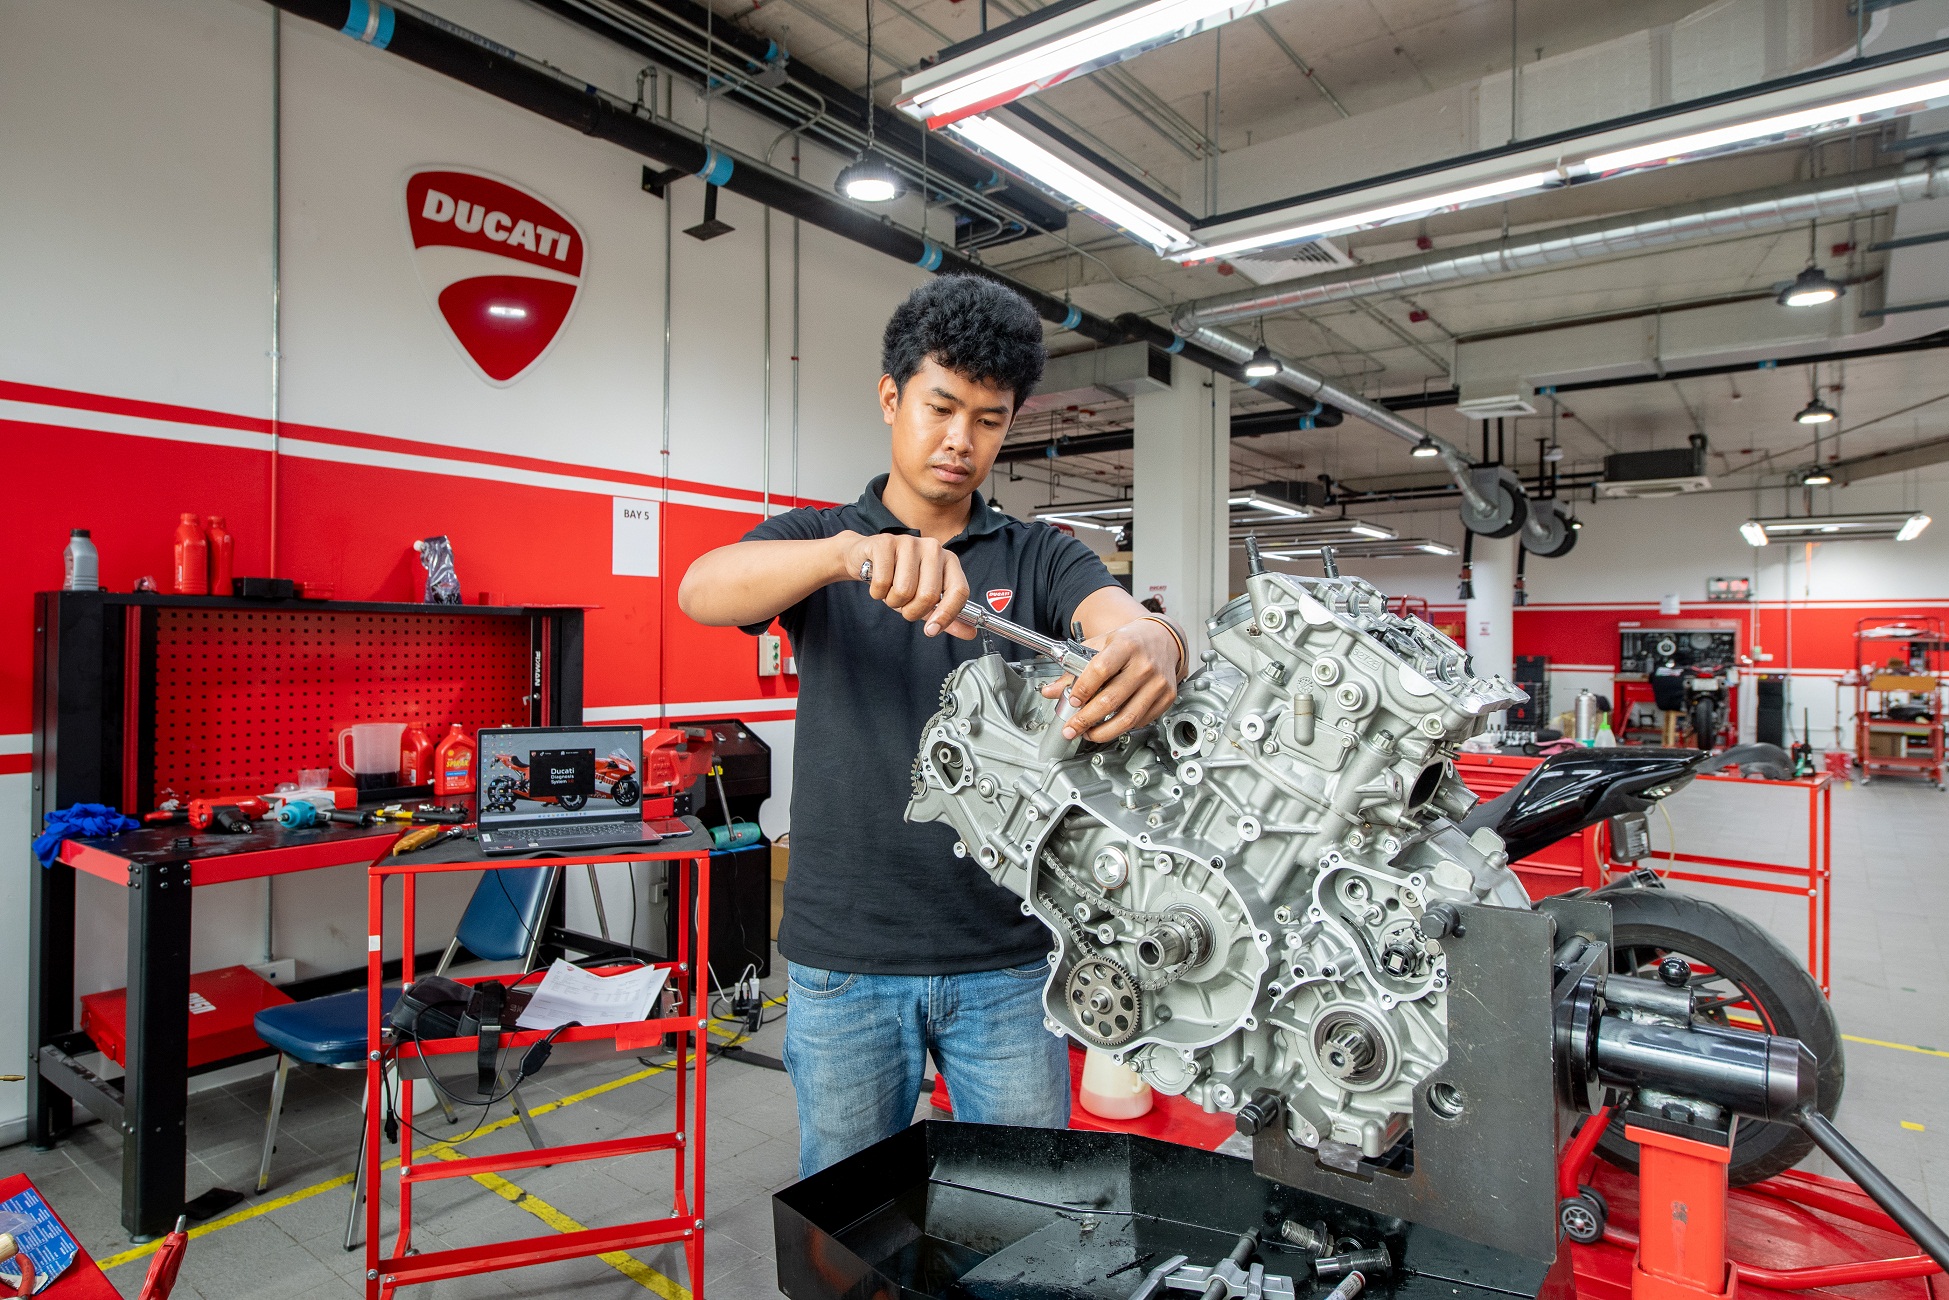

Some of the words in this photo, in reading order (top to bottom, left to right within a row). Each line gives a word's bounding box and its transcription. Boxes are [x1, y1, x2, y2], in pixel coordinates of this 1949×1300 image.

[422, 188, 571, 262] DUCATI
[624, 509, 642, 519] BAY
[644, 511, 650, 520] 5
